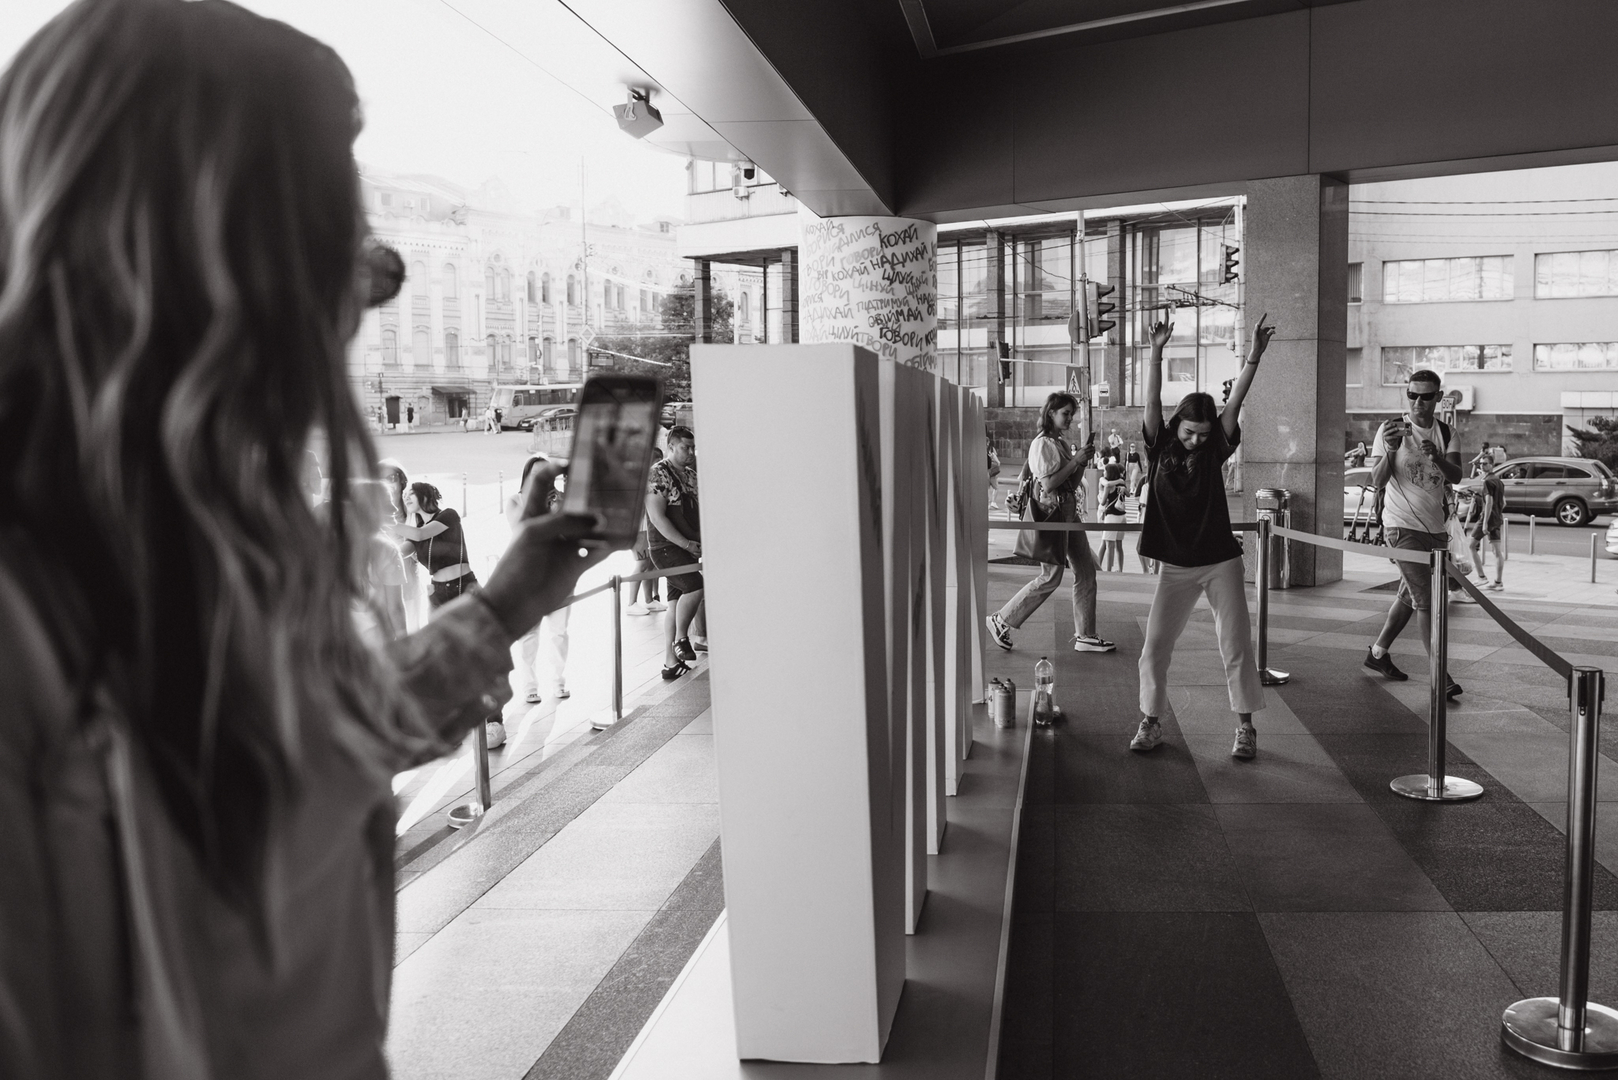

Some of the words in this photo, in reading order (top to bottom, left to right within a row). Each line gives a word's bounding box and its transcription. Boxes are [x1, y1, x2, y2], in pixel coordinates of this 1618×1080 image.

[878, 223, 918, 249] КОХАЙ
[831, 262, 870, 282] КОХАЙ
[869, 242, 929, 271] НАДИХАЙ
[840, 247, 885, 269] ГОВОРИ
[856, 295, 910, 315] ПІДТРИМУЙ
[857, 332, 897, 360] ТВОРИ
[879, 326, 923, 352] ГОВОРИ
